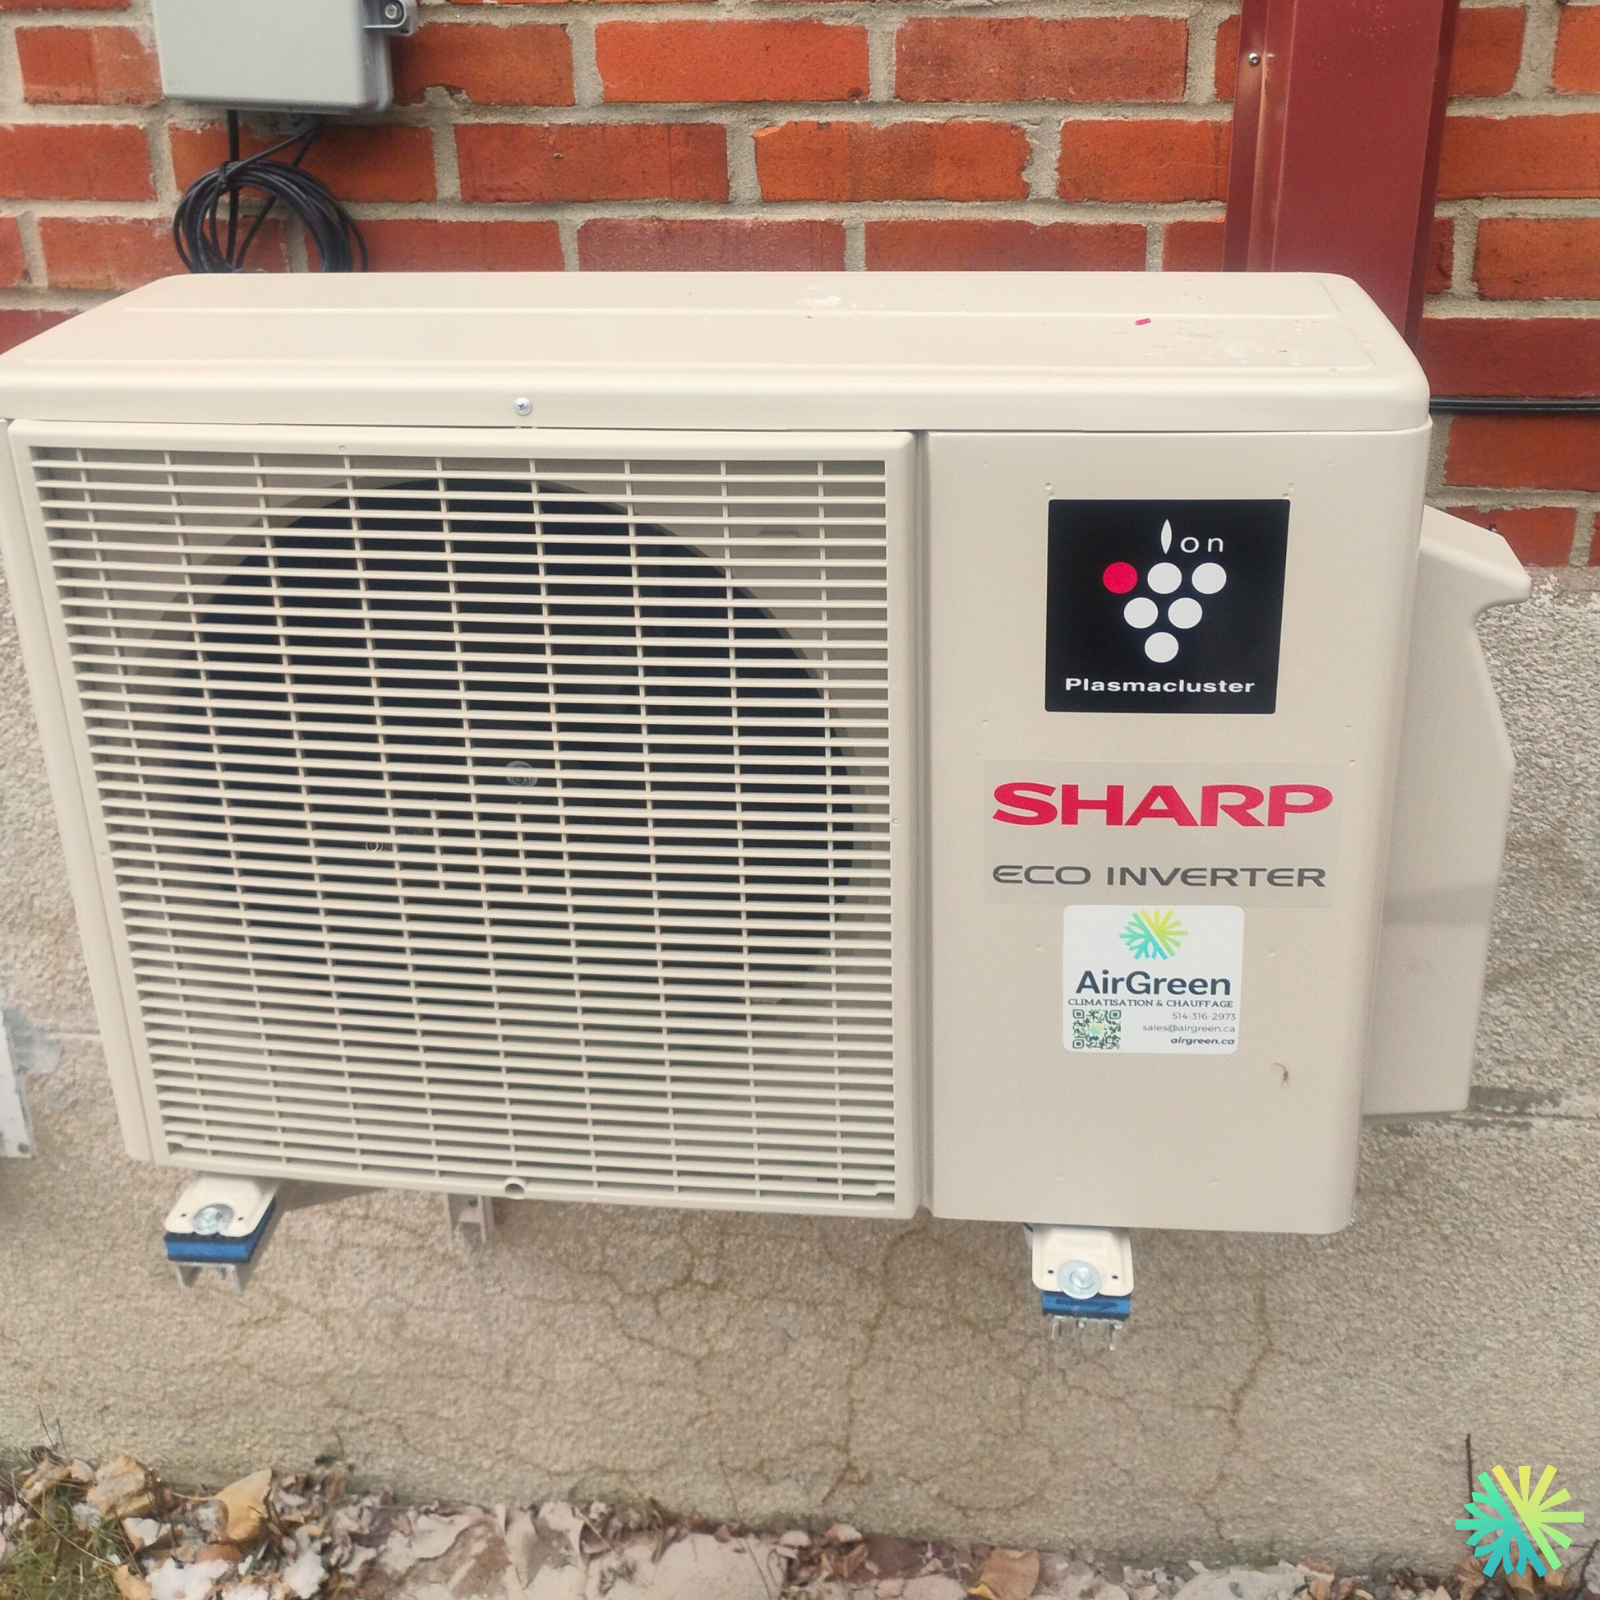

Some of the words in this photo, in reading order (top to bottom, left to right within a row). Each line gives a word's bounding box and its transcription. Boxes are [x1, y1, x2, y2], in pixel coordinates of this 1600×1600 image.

[1065, 678, 1255, 693] Plasmacluster
[992, 782, 1334, 827] SHARP
[992, 865, 1092, 885] ECO
[1107, 866, 1327, 888] INVERTER
[1075, 969, 1231, 996] AirGreen
[1067, 998, 1154, 1007] CLIMATISATION
[1166, 1000, 1234, 1008] CHAUFFAGE
[1171, 1012, 1237, 1021] 514-316-2973
[1142, 1024, 1236, 1034] sales@airgreen.ca
[1170, 1037, 1235, 1046] airgreen.ca
